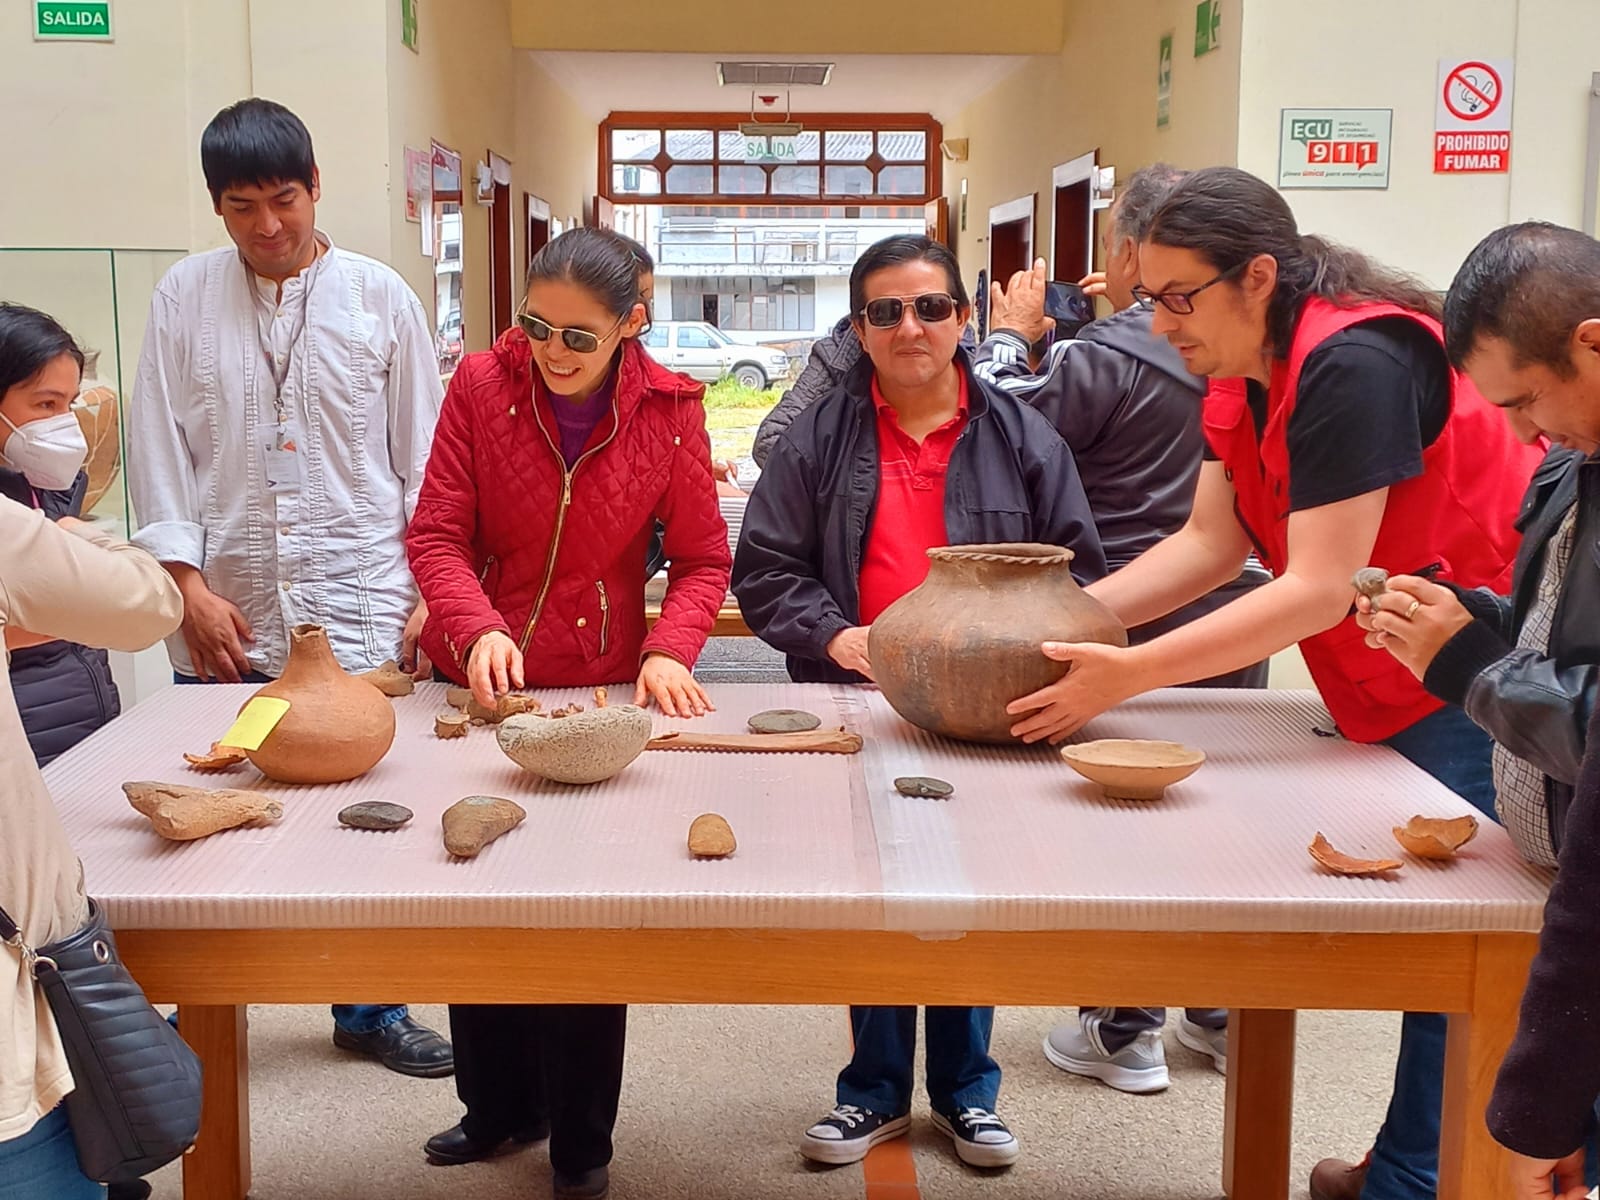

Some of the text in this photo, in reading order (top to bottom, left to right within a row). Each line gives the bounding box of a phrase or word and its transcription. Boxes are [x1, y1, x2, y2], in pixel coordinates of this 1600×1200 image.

[42, 11, 105, 26] SALIDA
[1293, 122, 1330, 138] ECU
[1437, 134, 1509, 151] PROHIBIDO
[1444, 154, 1501, 169] FUMAR
